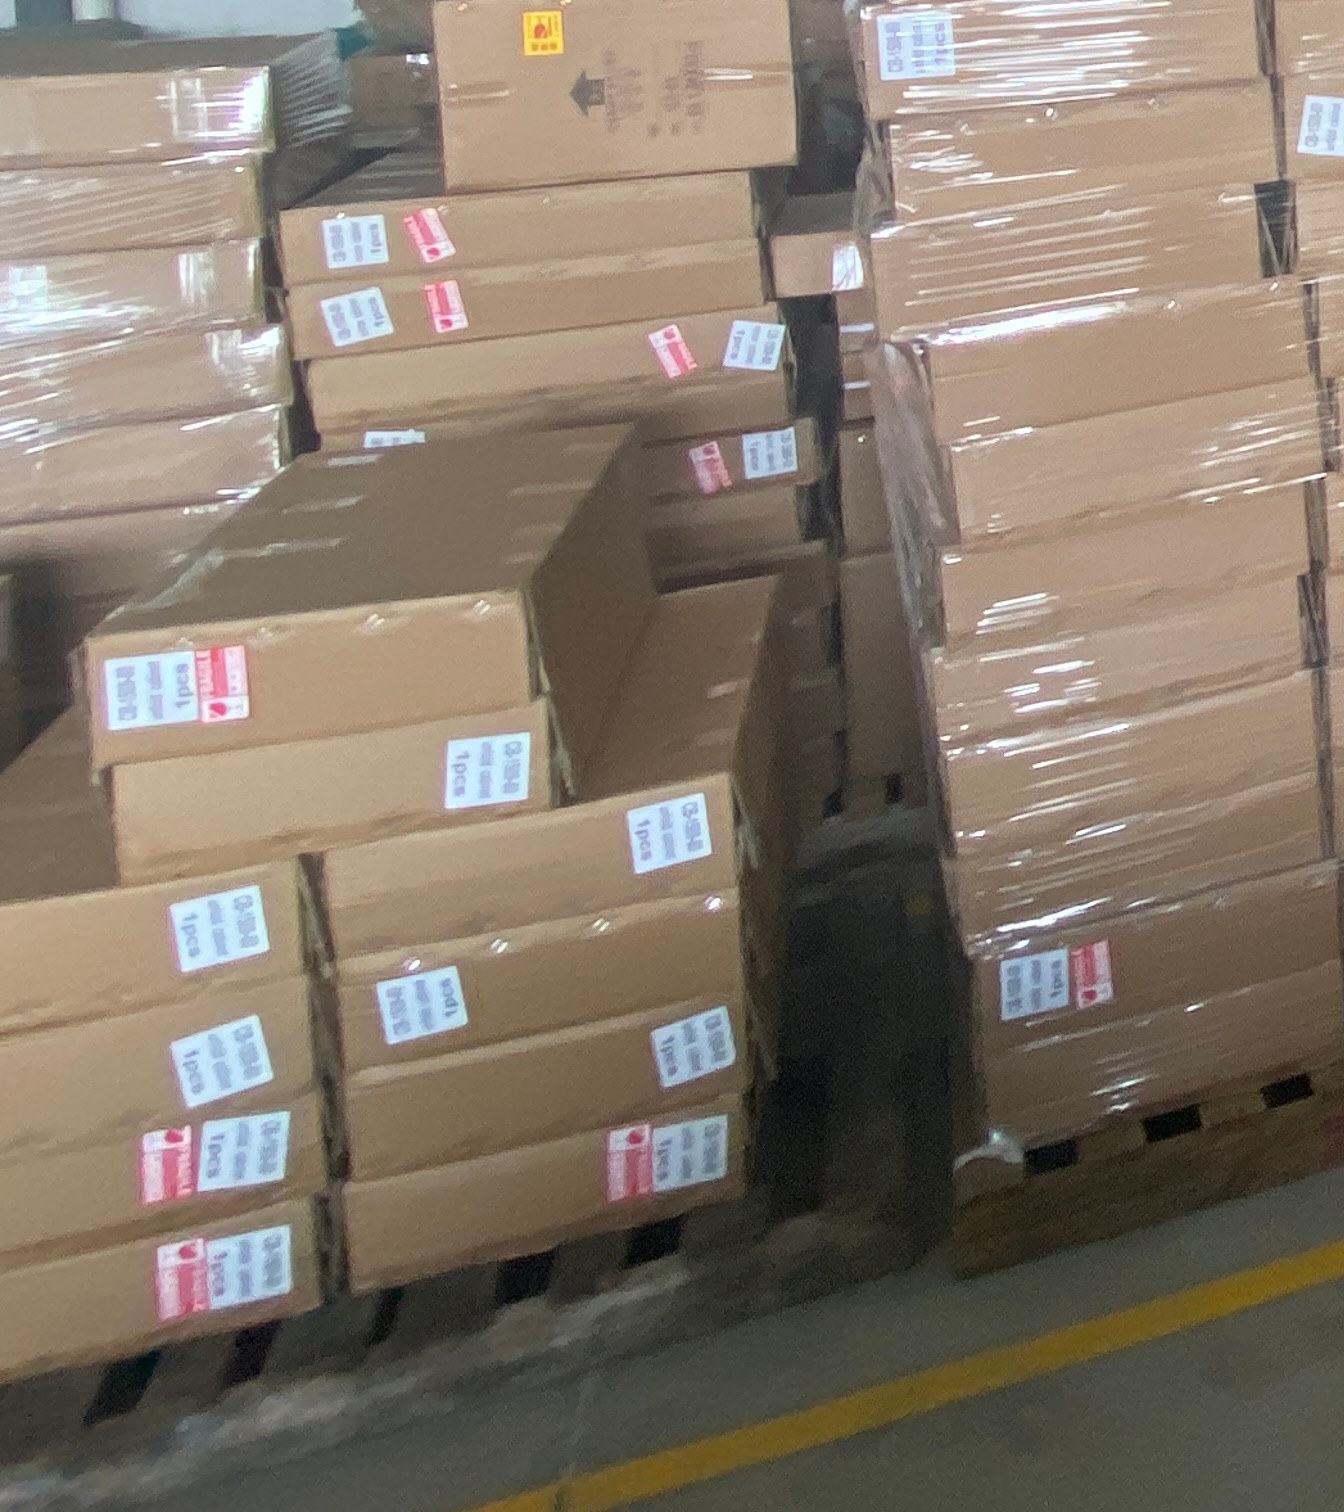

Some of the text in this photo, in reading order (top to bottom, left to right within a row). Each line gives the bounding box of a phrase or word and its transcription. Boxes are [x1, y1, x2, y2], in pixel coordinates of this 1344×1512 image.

[174, 663, 193, 709] 1pcs
[453, 750, 470, 797] 1pcs
[635, 818, 652, 861] 1pcs
[181, 912, 202, 958] 1pcs
